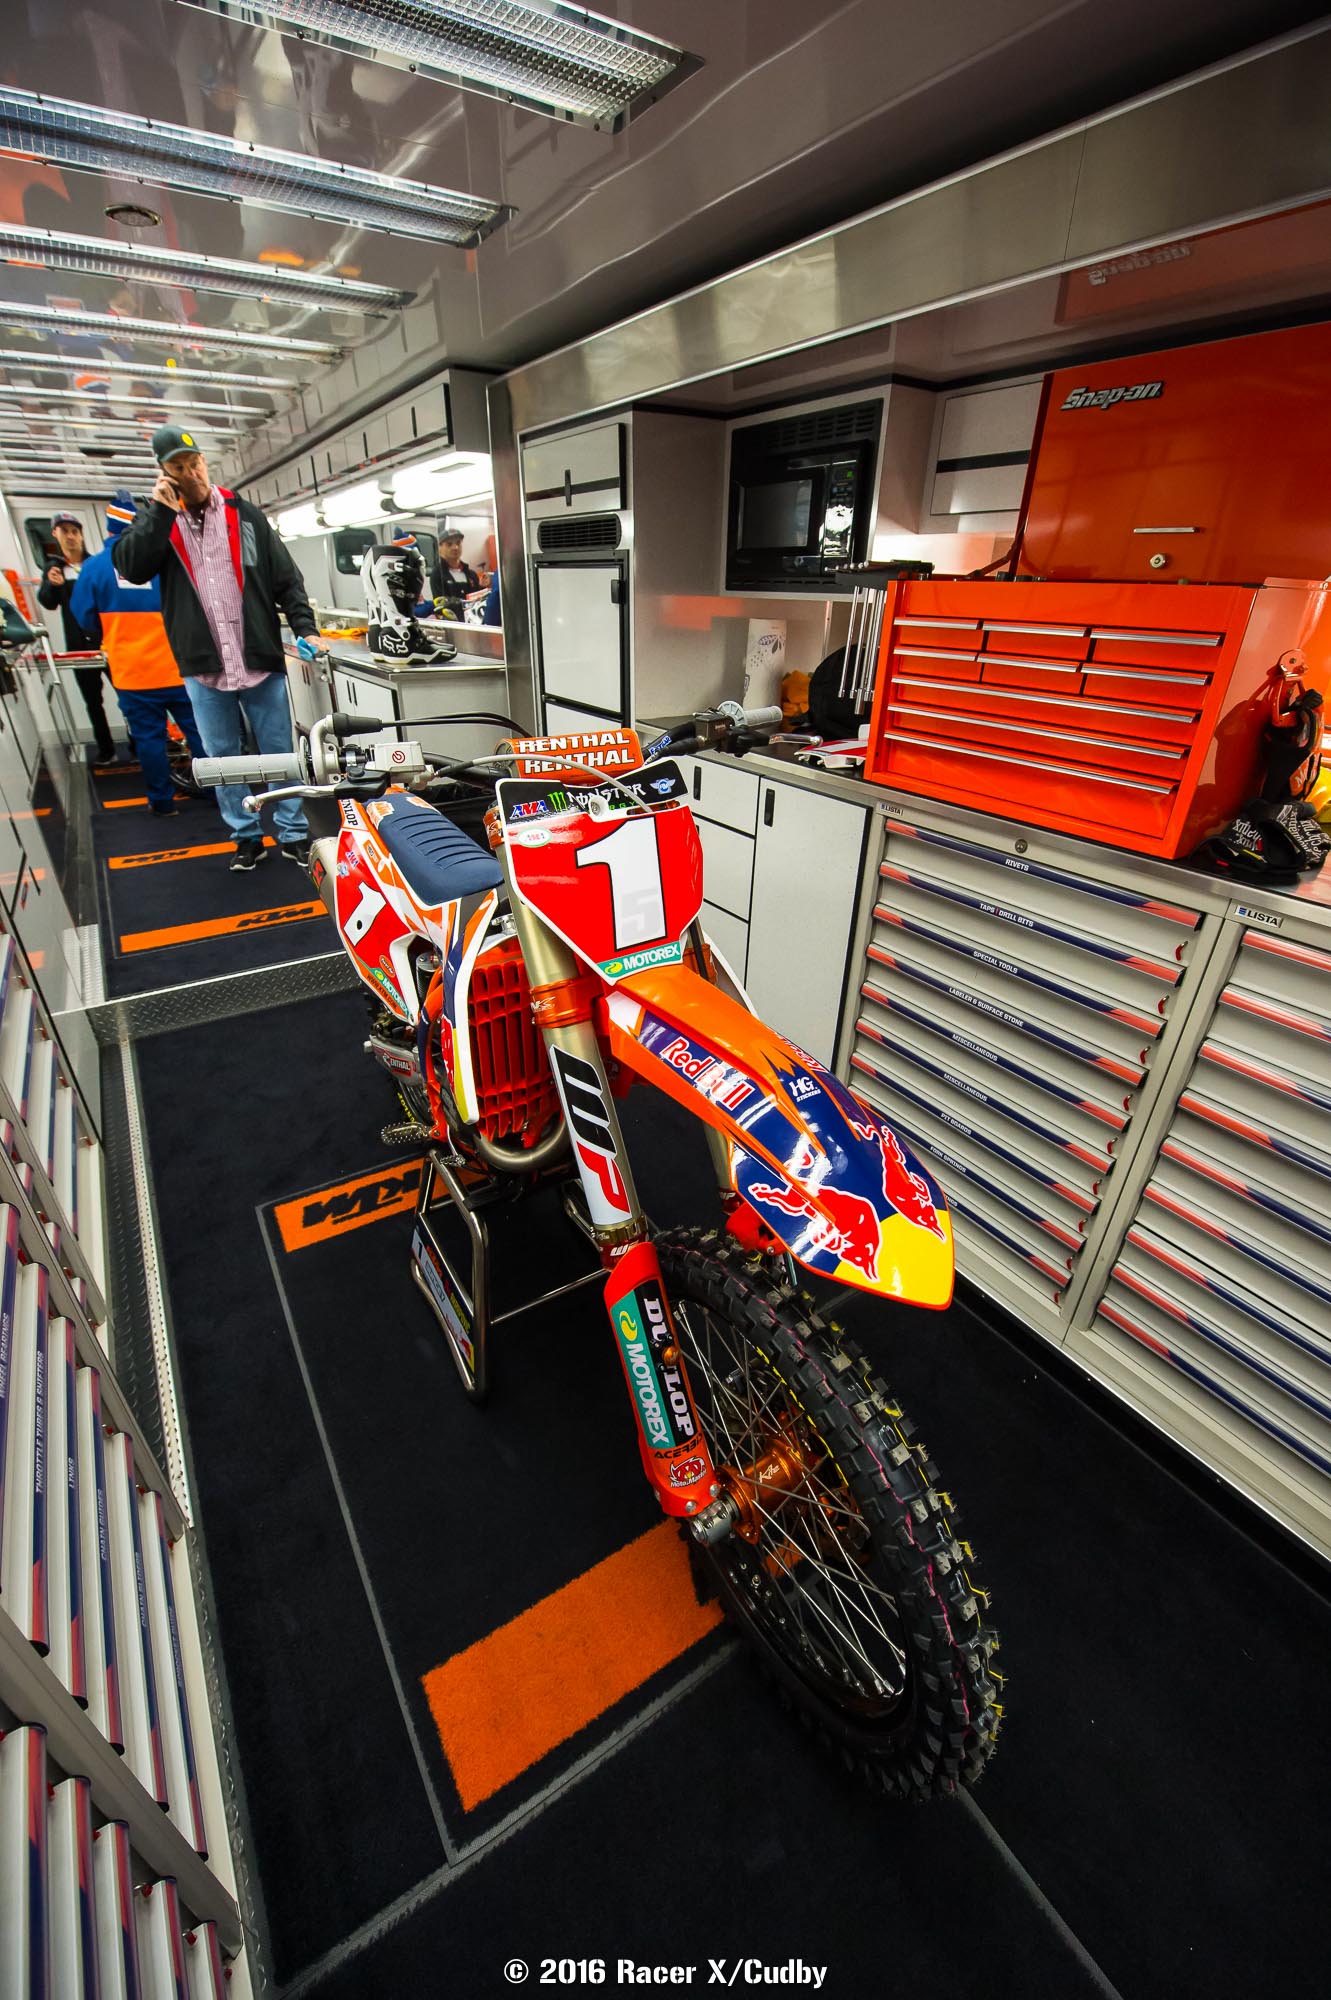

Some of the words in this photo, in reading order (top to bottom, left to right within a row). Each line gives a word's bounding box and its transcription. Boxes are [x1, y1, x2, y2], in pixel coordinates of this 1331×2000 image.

[1060, 380, 1164, 410] Snap-on
[518, 731, 631, 754] RENTHAL
[524, 748, 636, 775] RENTHAL
[509, 800, 550, 820] AMA
[1004, 857, 1030, 872] RIVETS
[576, 816, 669, 953] 1
[236, 906, 314, 928] KTM
[343, 881, 387, 947] 1
[979, 902, 996, 915] TAPS
[1017, 915, 1034, 928] BITS
[1246, 909, 1279, 926] LISTA
[622, 943, 681, 971] MOTOREX
[972, 950, 998, 966] SPECIAL
[998, 961, 1018, 975] TOOLS
[948, 987, 973, 1004] LABELER
[977, 1001, 1003, 1018] SURFACE
[951, 1033, 998, 1062] MISCELLANEOUS
[659, 1036, 716, 1080] Red
[694, 1062, 756, 1111] Bull
[943, 1073, 988, 1102] MISCELLANEOUS
[796, 1088, 821, 1103] STICKERS
[302, 1167, 422, 1229] KTM
[643, 1297, 694, 1437] DULOP
[626, 1343, 670, 1446] MOTOREX
